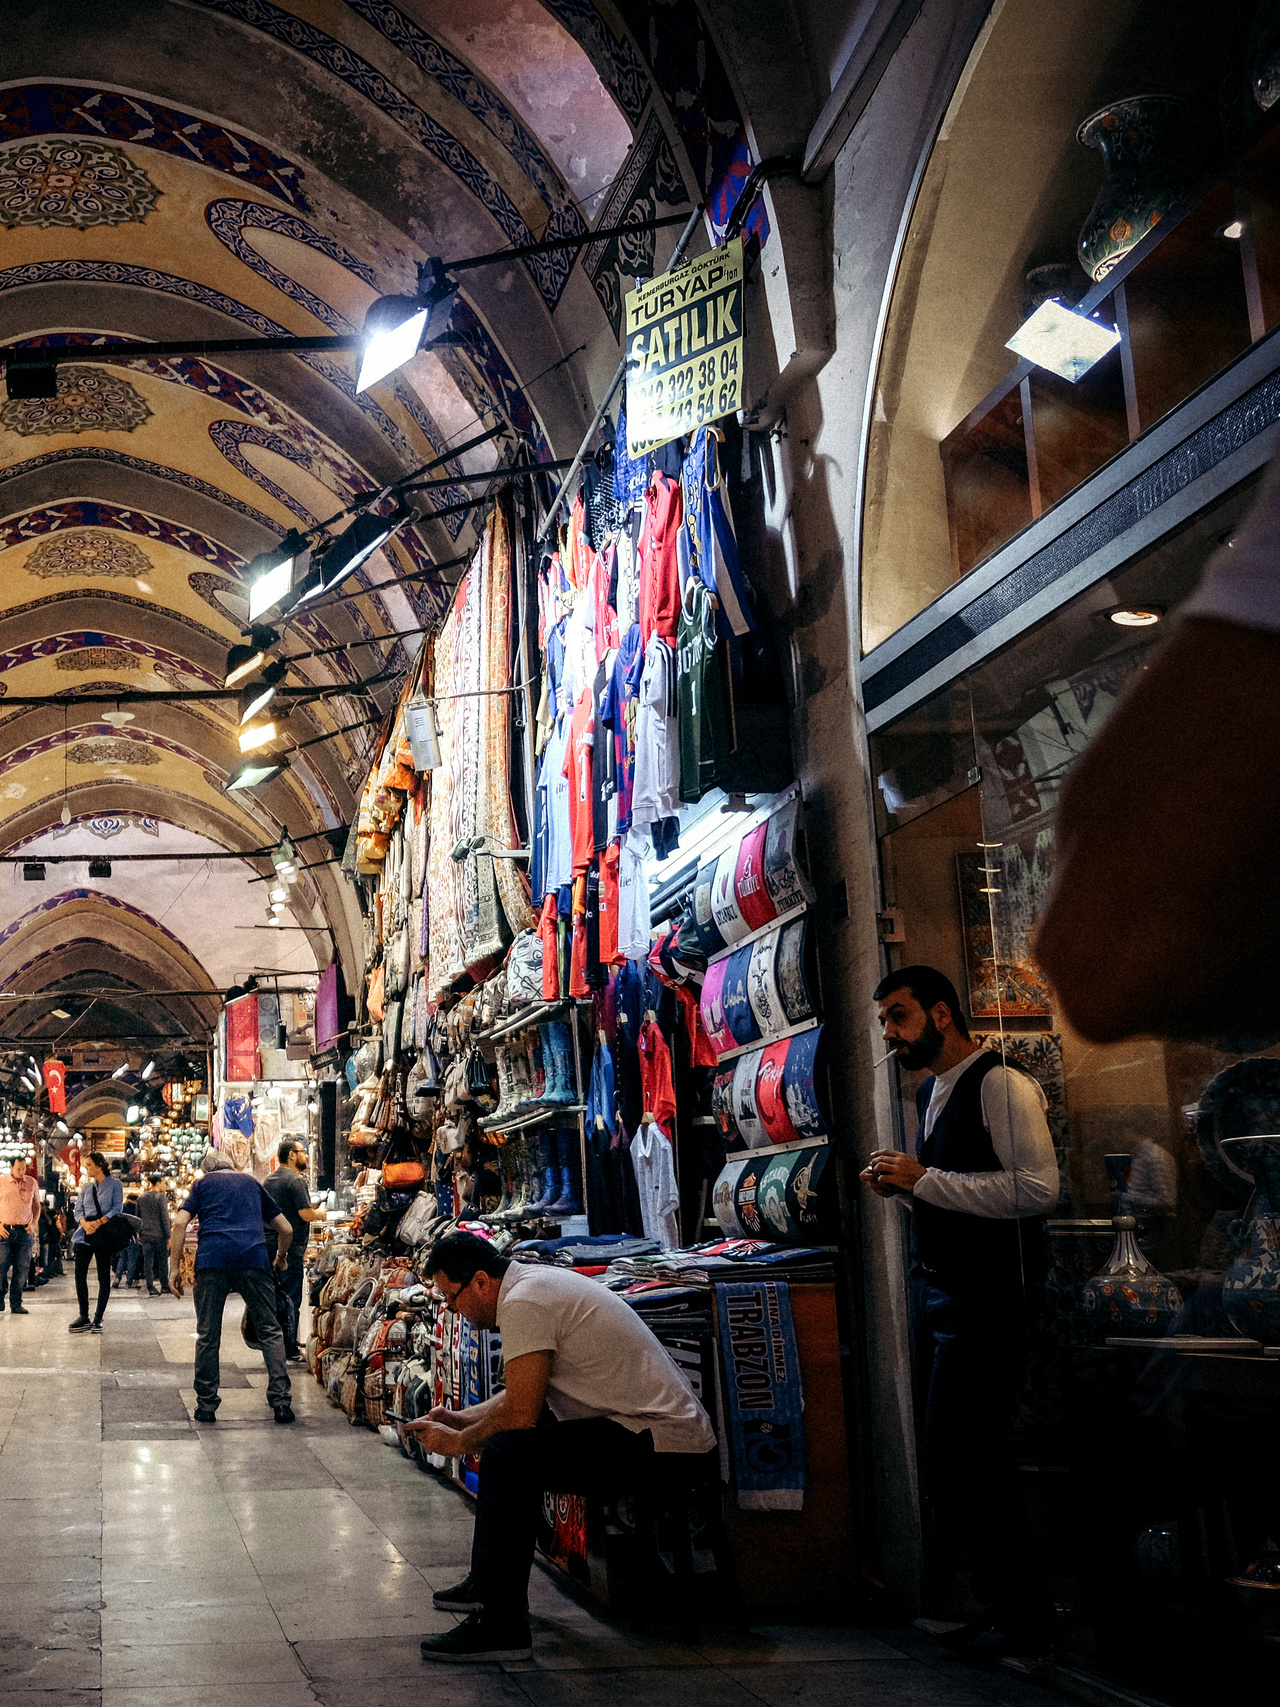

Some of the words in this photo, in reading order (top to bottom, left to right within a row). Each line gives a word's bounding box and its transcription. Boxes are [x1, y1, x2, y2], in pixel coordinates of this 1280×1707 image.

[631, 269, 724, 326] TURYAP
[638, 269, 690, 303] KEMERBURGAZ
[691, 252, 731, 275] GÖKTÜRK
[631, 288, 738, 380] SATILIK
[669, 366, 694, 405] 322
[698, 356, 716, 391] 38
[720, 345, 738, 381] 04
[697, 389, 714, 424] 54
[719, 379, 737, 414] 62
[725, 1290, 774, 1411] TRABZON
[770, 1329, 787, 1383] DİNMEZ
